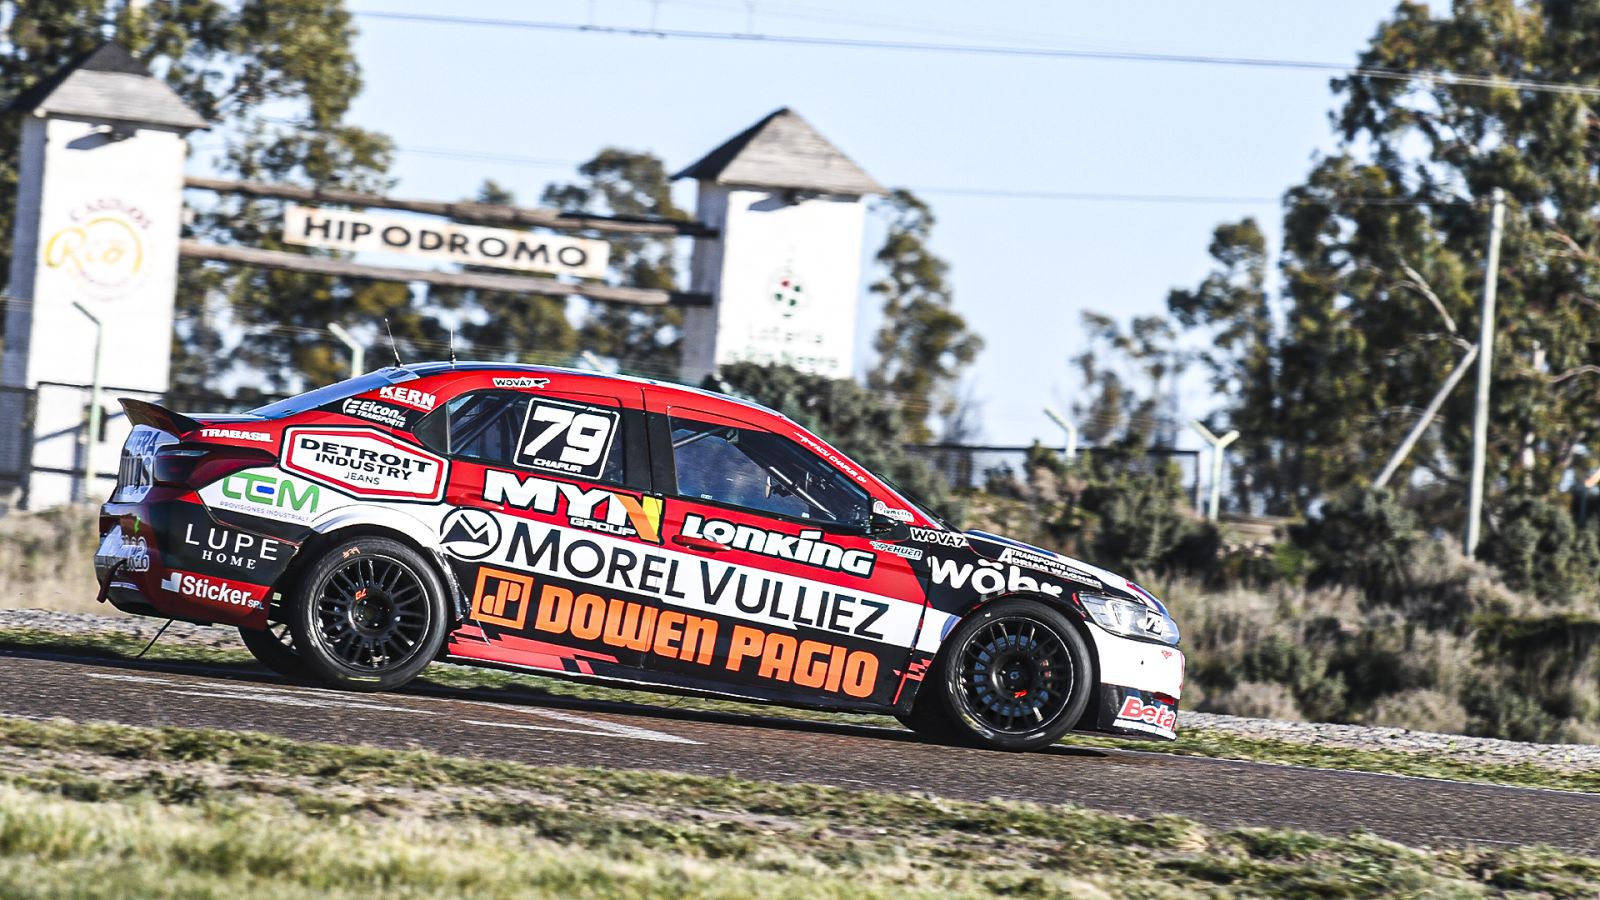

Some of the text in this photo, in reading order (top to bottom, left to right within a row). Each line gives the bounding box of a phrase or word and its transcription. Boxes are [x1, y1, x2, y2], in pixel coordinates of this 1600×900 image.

[303, 216, 588, 267] HIPODROMO
[379, 386, 436, 407] KERN
[200, 428, 274, 442] TRABASIL
[522, 405, 611, 466] 79
[299, 437, 432, 473] DETROIT
[315, 452, 413, 481] INDUSTRY
[533, 457, 583, 474] CHAPUR
[344, 472, 381, 485] JEANS
[569, 516, 637, 537] GROUP
[911, 528, 965, 548] WOVA7
[185, 523, 280, 561] LUPE
[201, 550, 257, 570] HOME
[181, 574, 252, 605] Sticker
[505, 521, 890, 640] MOREL VULLIEZ
[534, 584, 880, 699] DOWEN PAGIO
[1121, 698, 1175, 728] Beta
